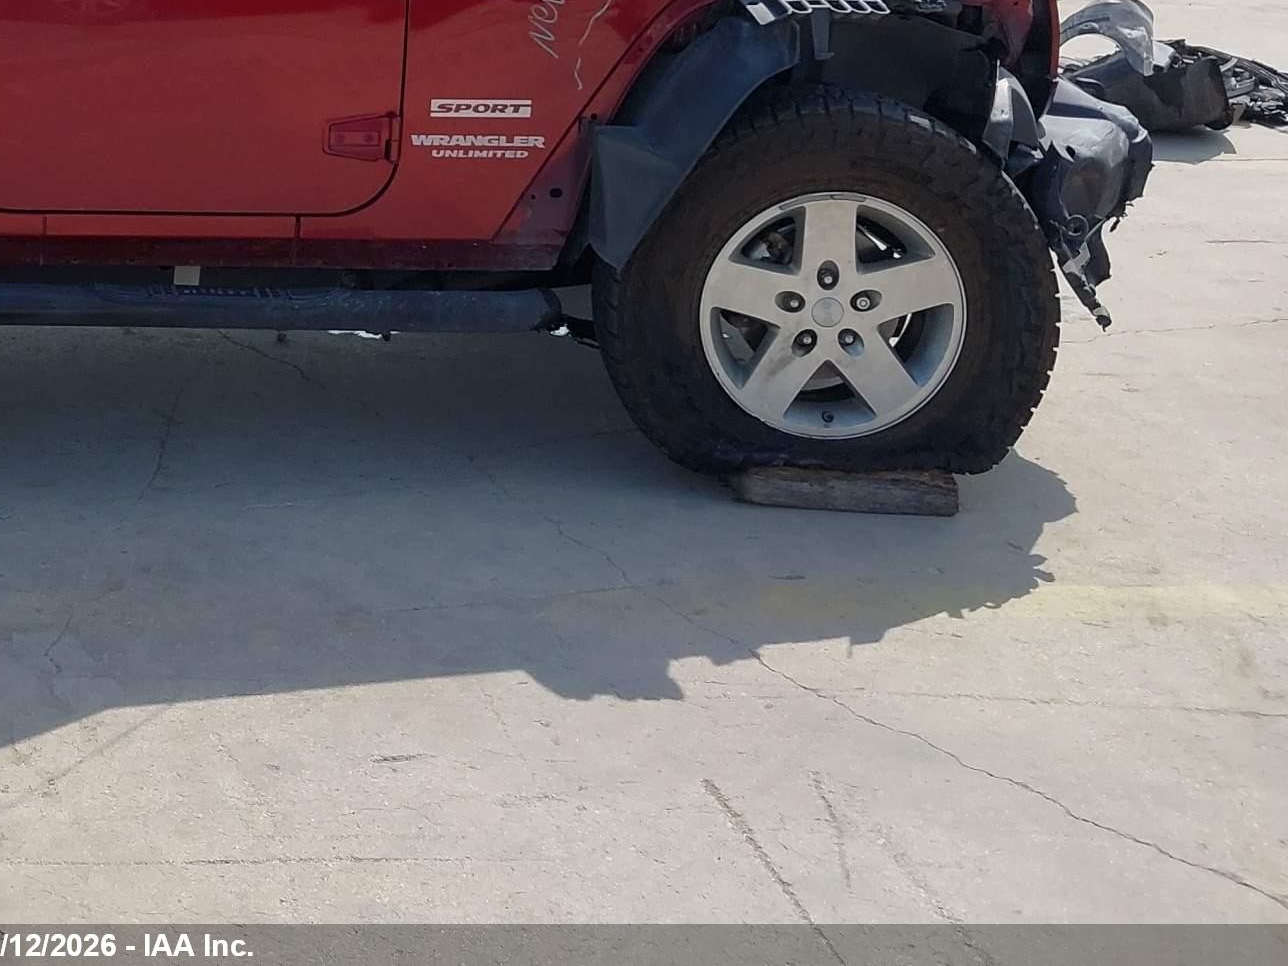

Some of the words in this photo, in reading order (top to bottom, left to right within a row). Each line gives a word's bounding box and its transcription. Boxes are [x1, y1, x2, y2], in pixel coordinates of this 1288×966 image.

[430, 102, 532, 115] SPORT
[410, 134, 546, 148] WRANGLER
[431, 149, 529, 159] UNLIMITED
